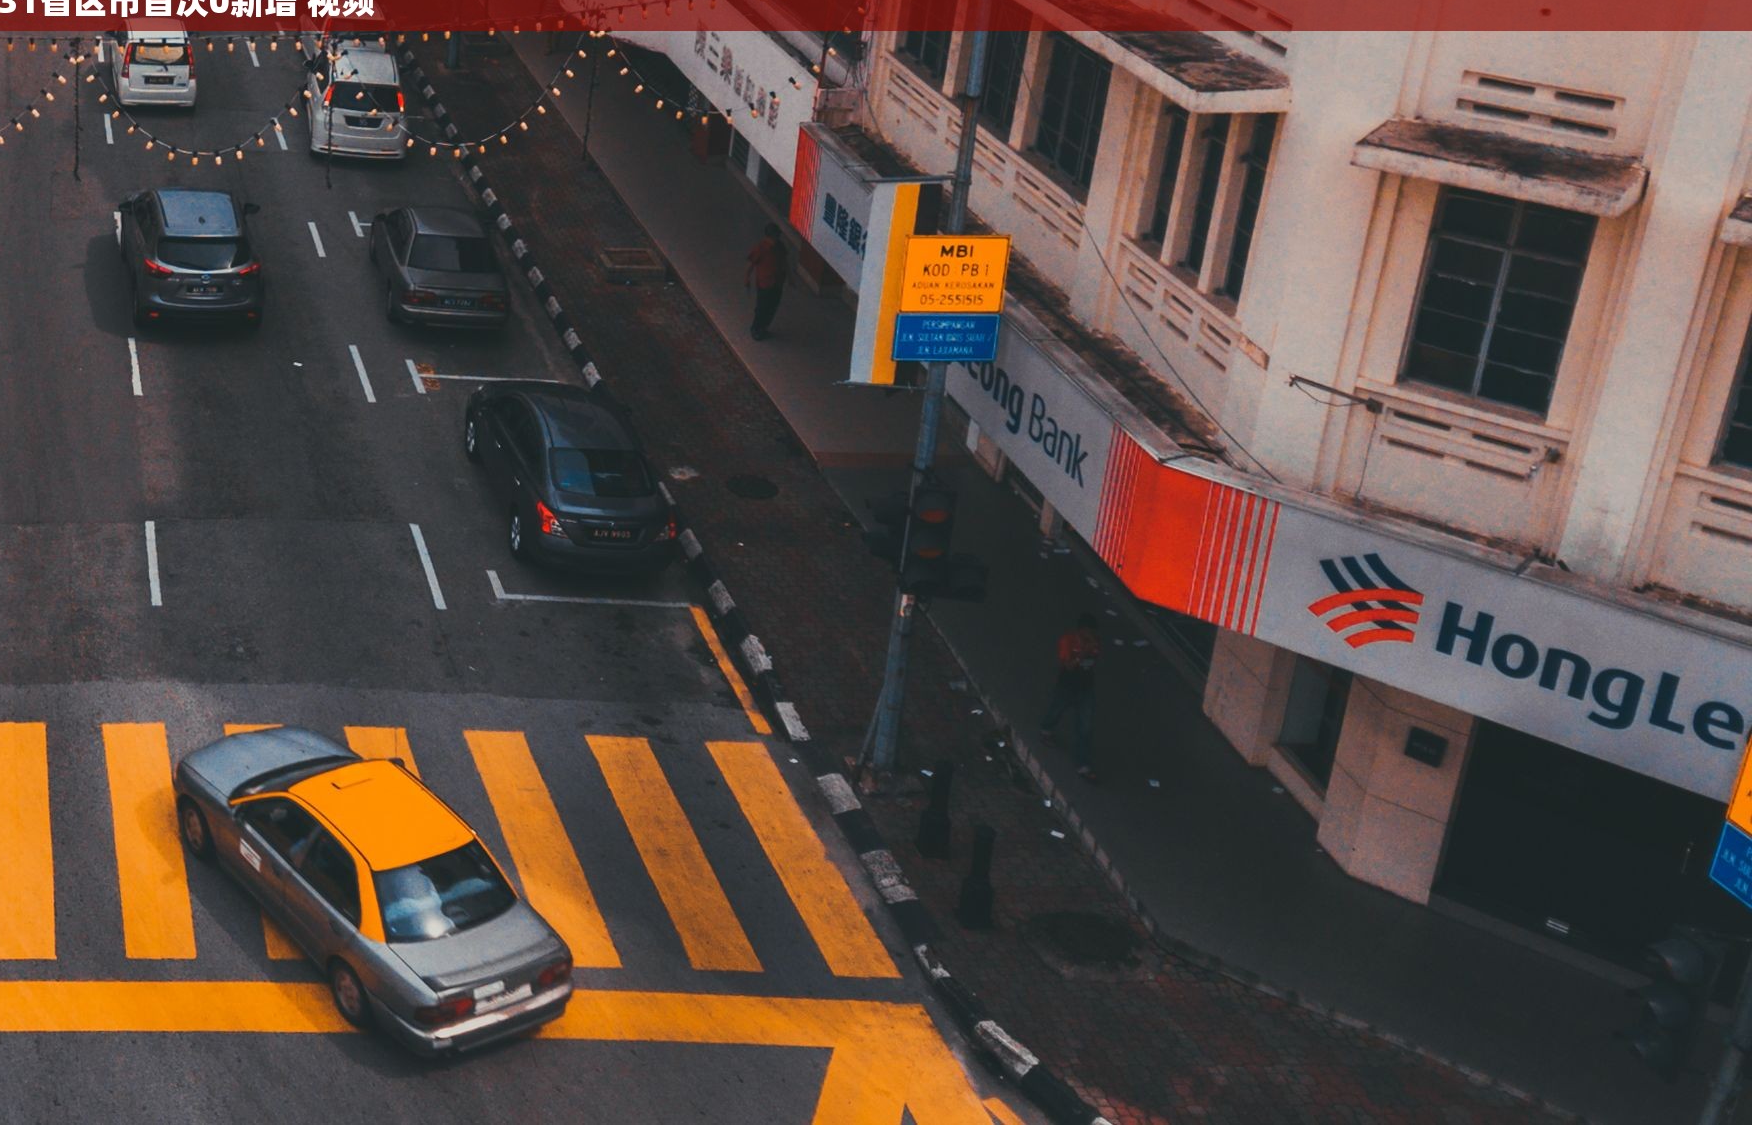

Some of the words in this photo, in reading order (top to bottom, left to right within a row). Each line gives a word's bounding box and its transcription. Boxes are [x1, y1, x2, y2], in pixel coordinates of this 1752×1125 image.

[940, 245, 974, 258] MBI
[922, 264, 950, 276] KOD
[912, 280, 940, 289] ADUAN
[945, 280, 995, 289] KEROSAKAN
[920, 295, 984, 306] 05-2551515
[1028, 392, 1088, 489] Bank
